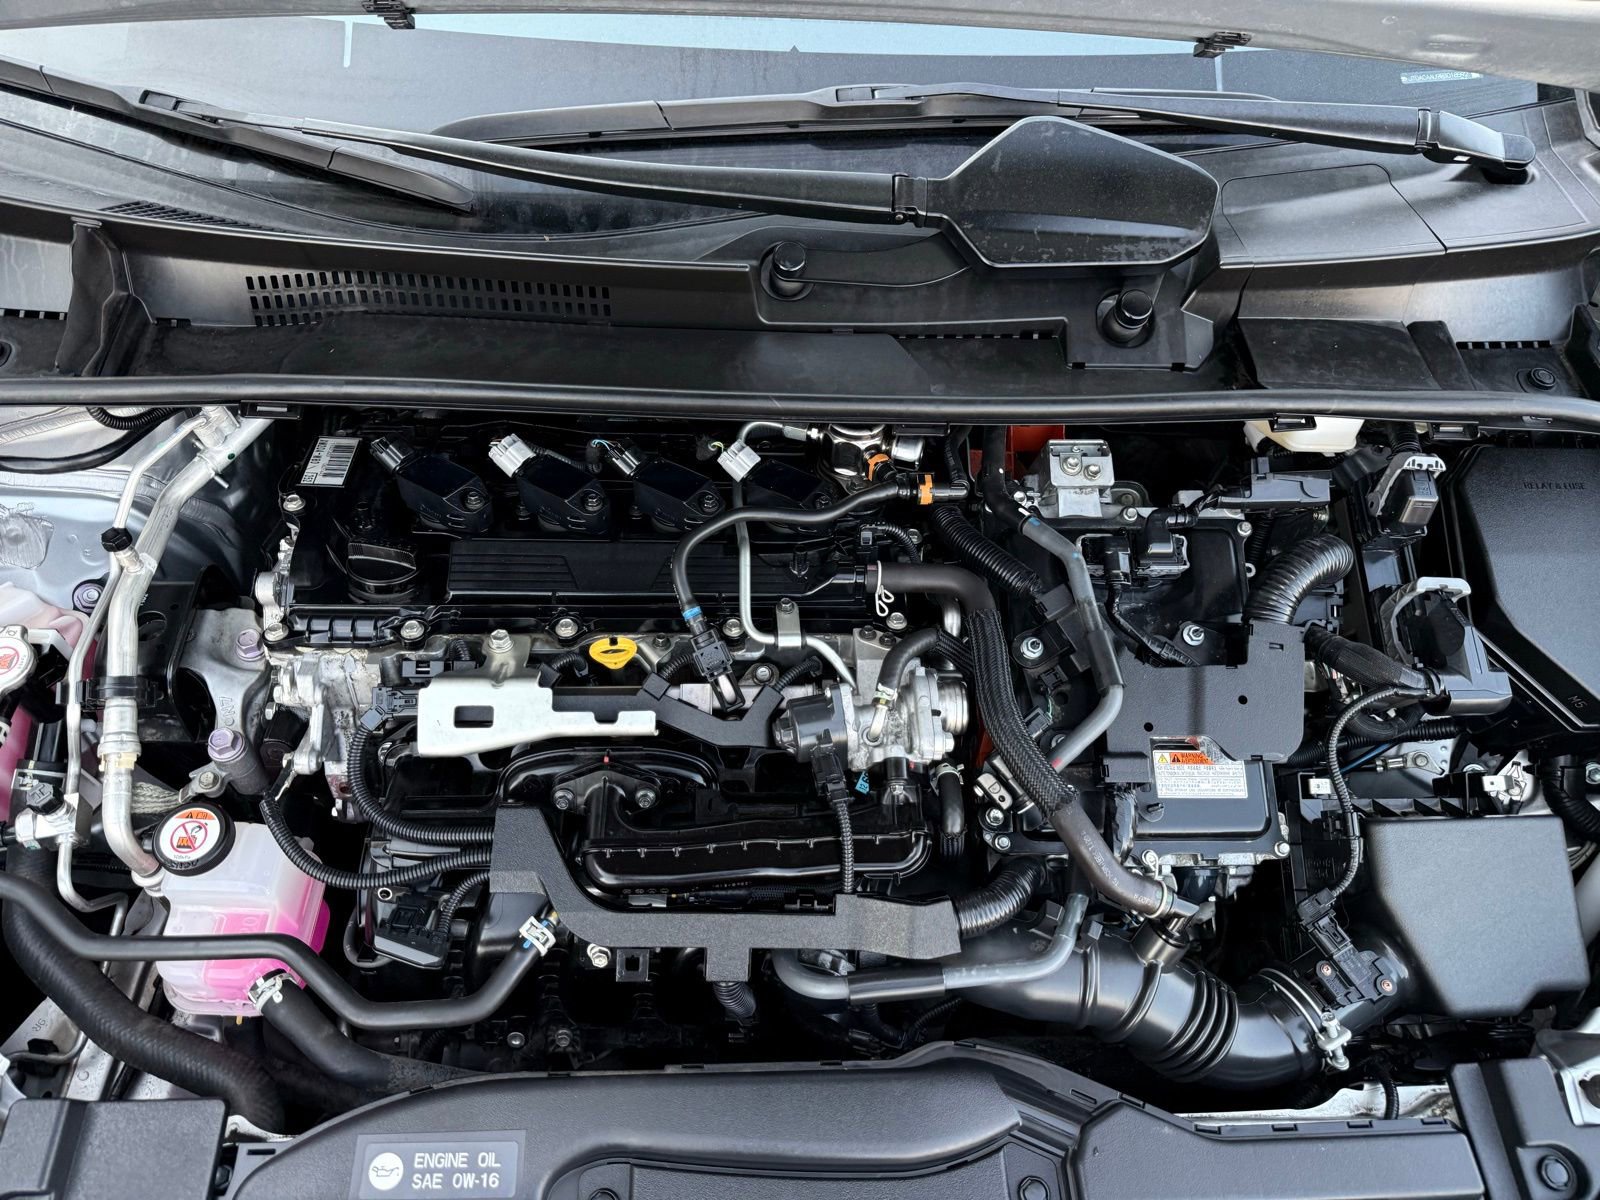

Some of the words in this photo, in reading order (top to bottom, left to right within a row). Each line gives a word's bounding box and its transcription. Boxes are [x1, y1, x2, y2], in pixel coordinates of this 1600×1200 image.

[413, 1152, 470, 1169] ENGINE
[477, 1151, 502, 1168] OIL
[411, 1172, 444, 1190] SAE
[452, 1172, 501, 1190] 0W-16
